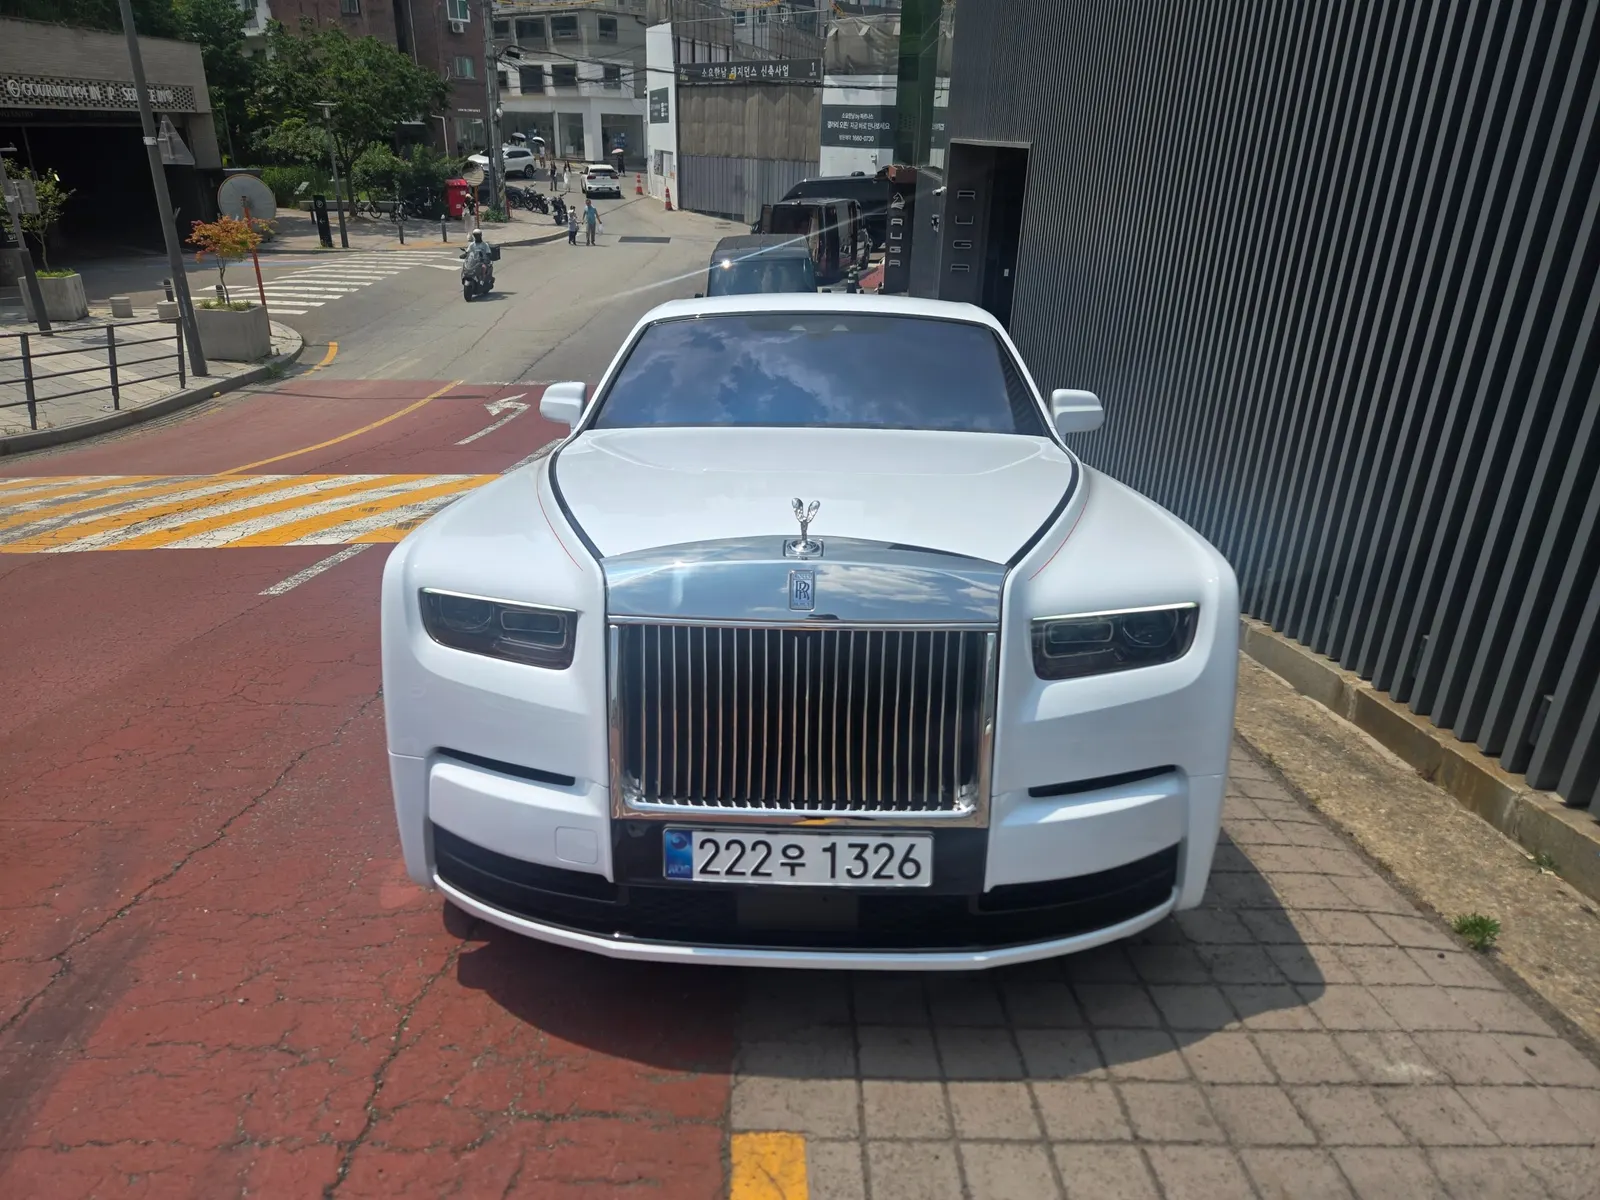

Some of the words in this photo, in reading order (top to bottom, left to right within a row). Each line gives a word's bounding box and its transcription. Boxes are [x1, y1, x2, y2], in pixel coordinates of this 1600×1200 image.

[701, 68, 727, 77] 소요한남
[760, 64, 789, 77] 신축사업
[811, 62, 815, 71] 1
[795, 580, 810, 600] RR
[698, 838, 806, 877] 222우
[822, 842, 922, 880] 1326
